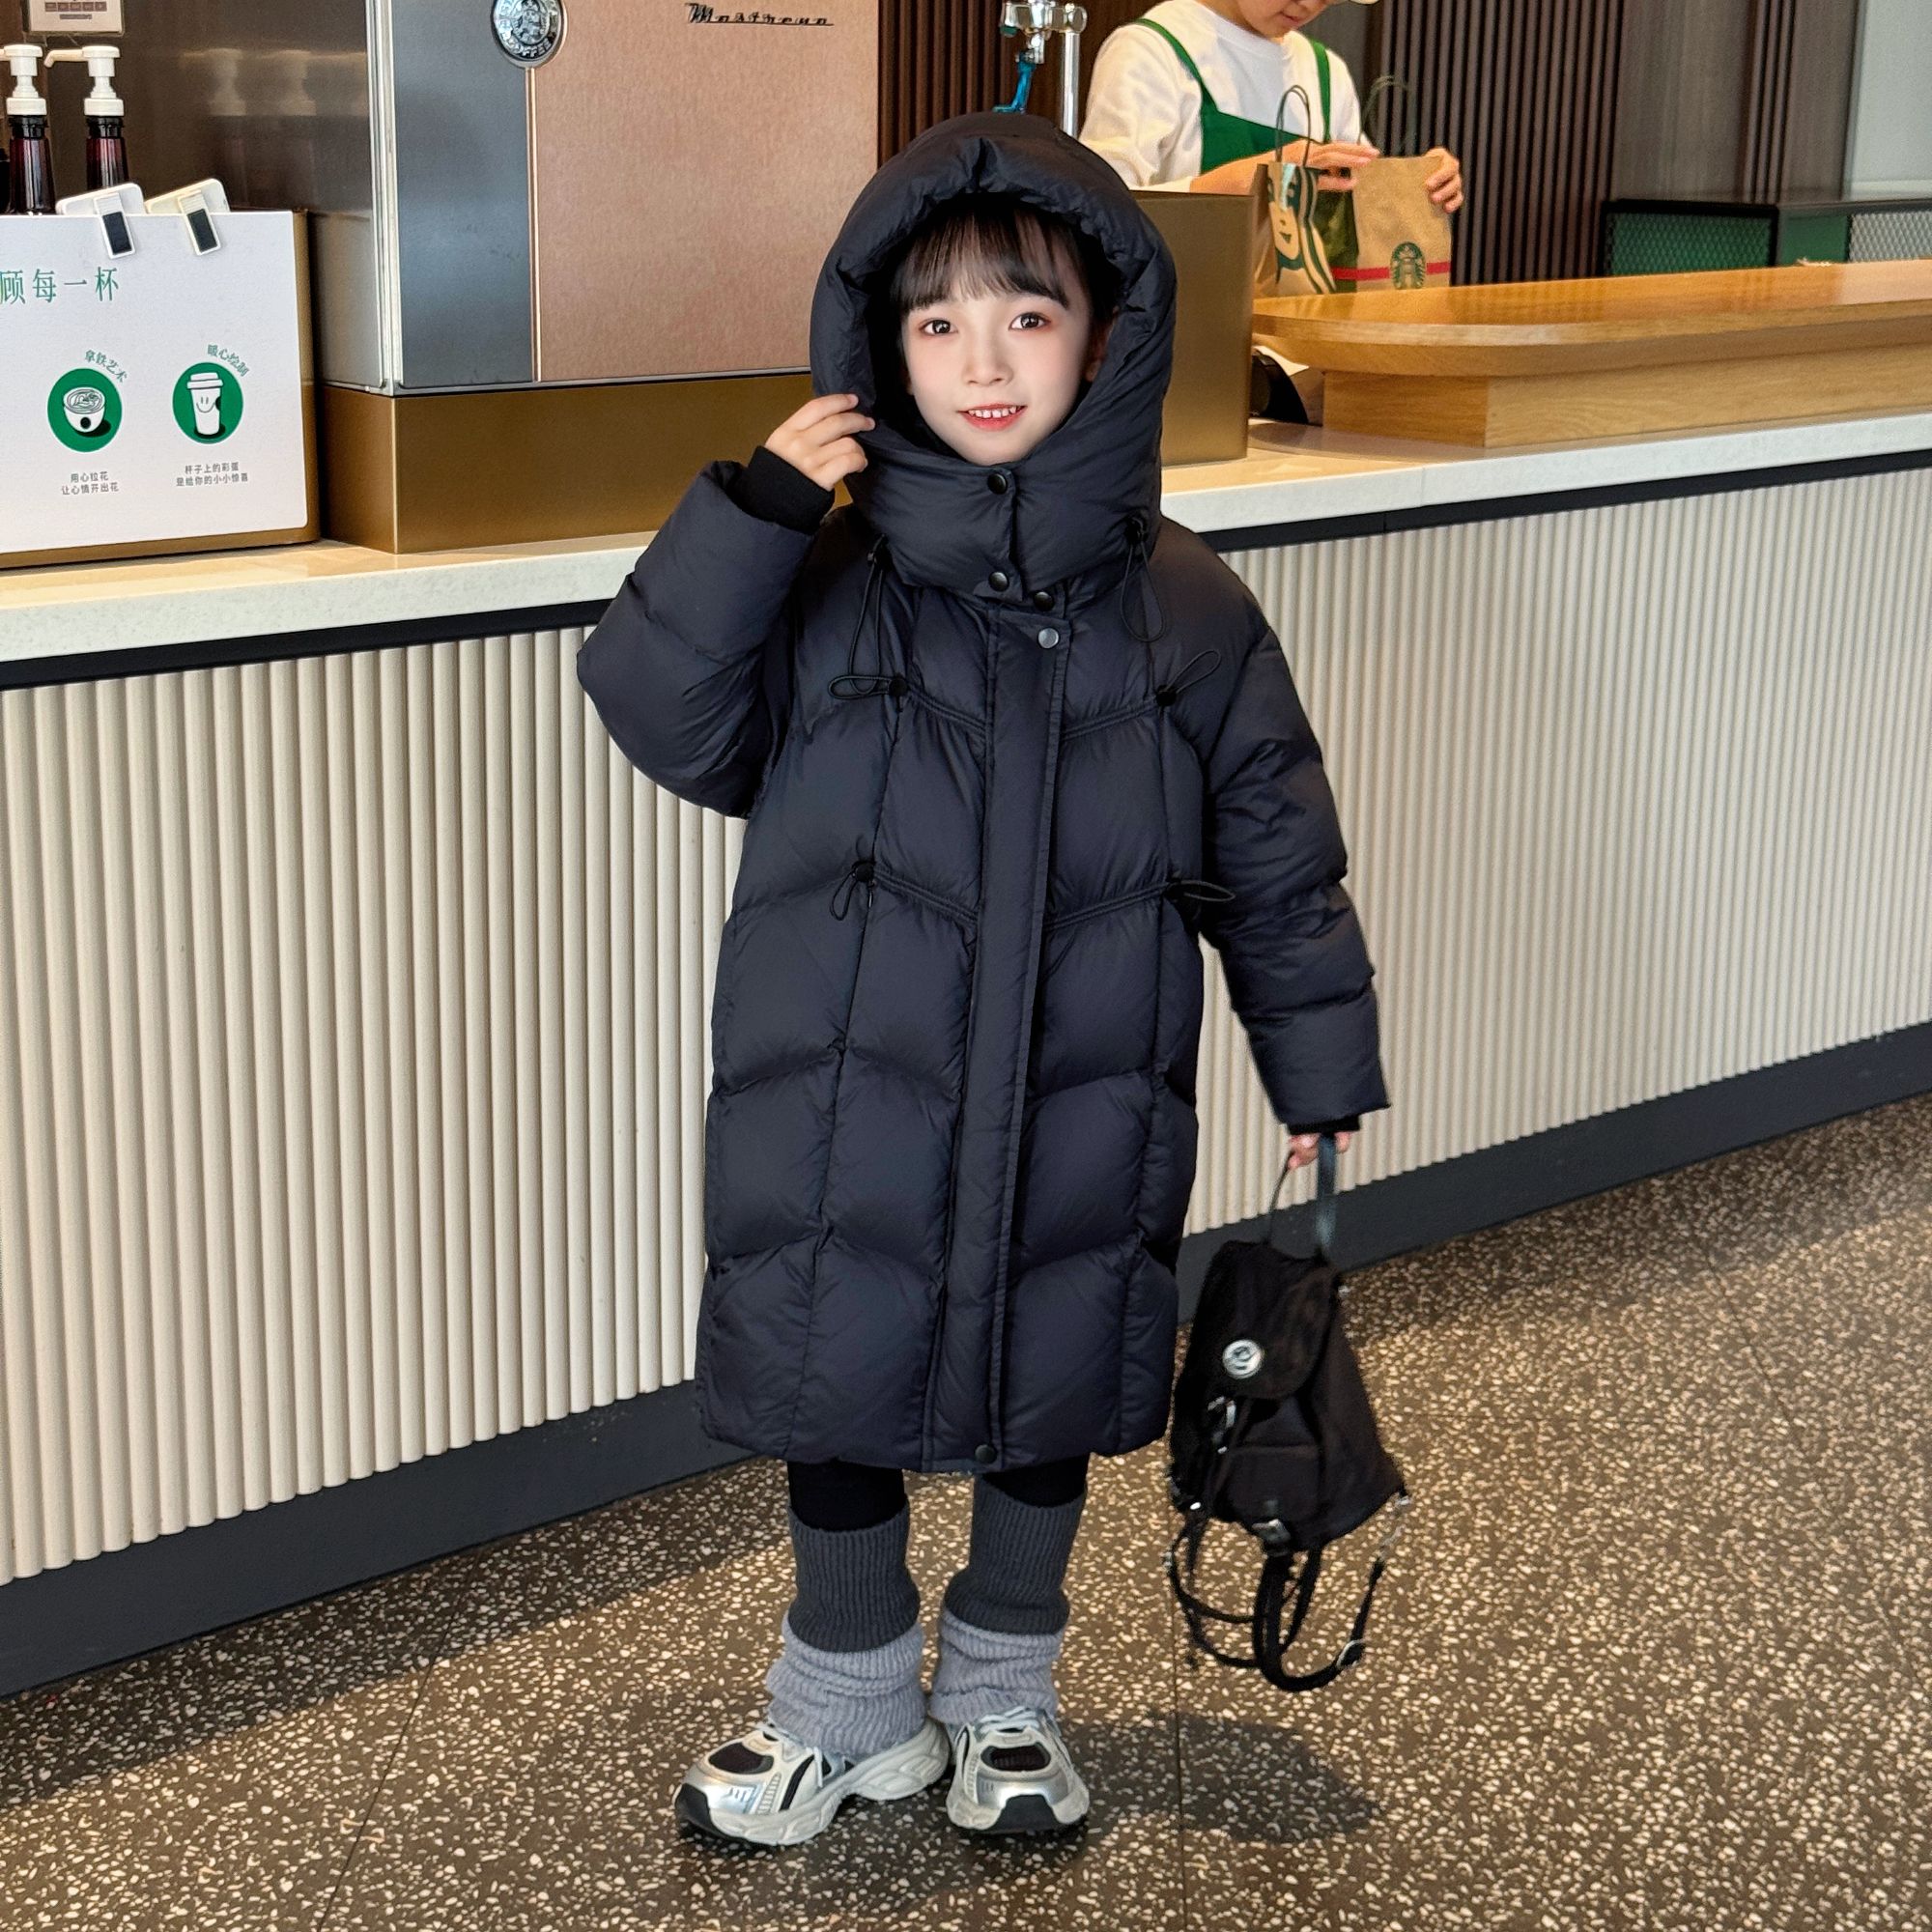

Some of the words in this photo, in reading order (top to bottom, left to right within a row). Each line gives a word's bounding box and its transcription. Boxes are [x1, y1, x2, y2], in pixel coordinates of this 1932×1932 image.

[0, 267, 119, 304] 顾每一杯
[84, 349, 127, 383] 拿铁艺术
[185, 462, 239, 474] 杯子上的彩蛋
[71, 470, 109, 483] 用心拉花
[176, 472, 248, 486] 是给你的小小惊喜
[61, 481, 119, 496] 让心情开出花
